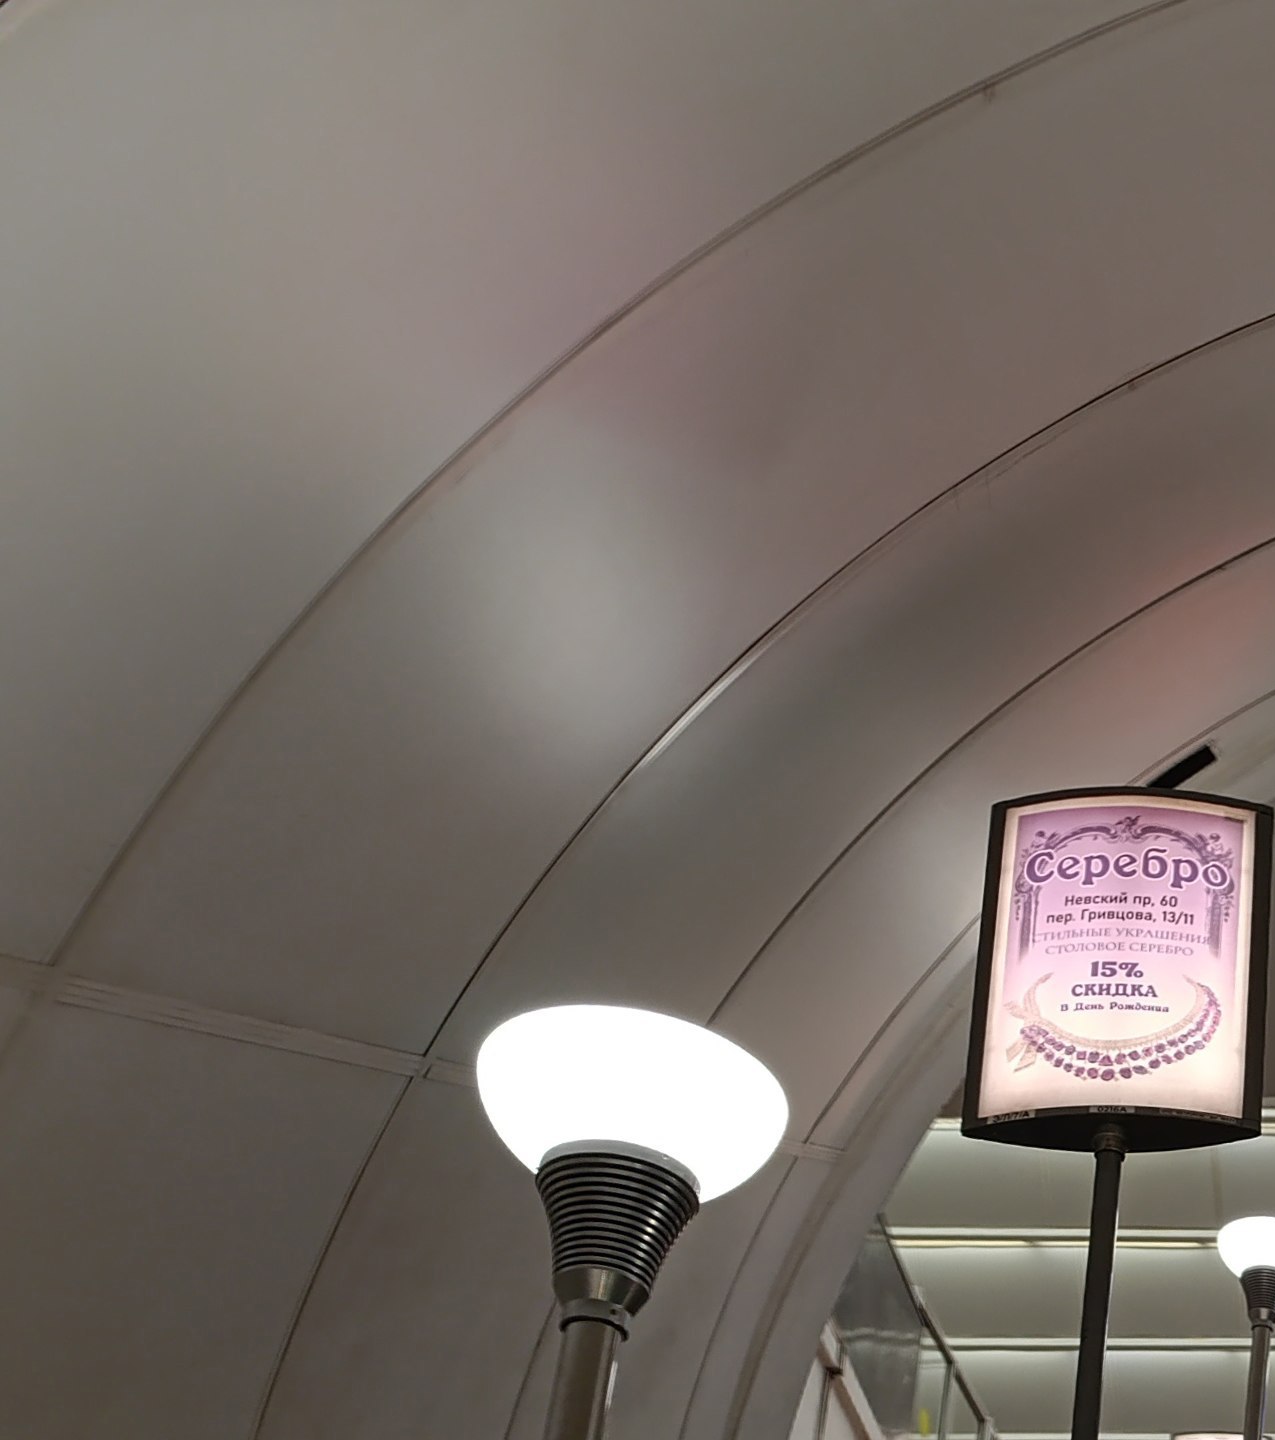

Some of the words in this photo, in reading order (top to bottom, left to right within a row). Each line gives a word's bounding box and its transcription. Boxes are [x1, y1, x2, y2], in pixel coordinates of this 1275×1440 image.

[1026, 848, 1228, 889] Серебро
[1064, 892, 1128, 907] Невский
[1160, 896, 1178, 908] 60
[1046, 913, 1076, 925] пер.
[1081, 909, 1157, 923] Гривцова,
[1162, 911, 1194, 925] 13/11
[1033, 928, 1111, 944] СТИЛЬНЫЕ
[1115, 927, 1211, 945] УКРАШЕНИЯ
[1045, 941, 1126, 955] СТОЛОВОЕ
[1129, 942, 1194, 957] СЕРЕБРО
[1090, 961, 1144, 978] 15%
[1071, 984, 1159, 998] СКИДКА
[1060, 1003, 1069, 1012] В
[1073, 1002, 1104, 1012] День
[1109, 1001, 1170, 1013] Рождения
